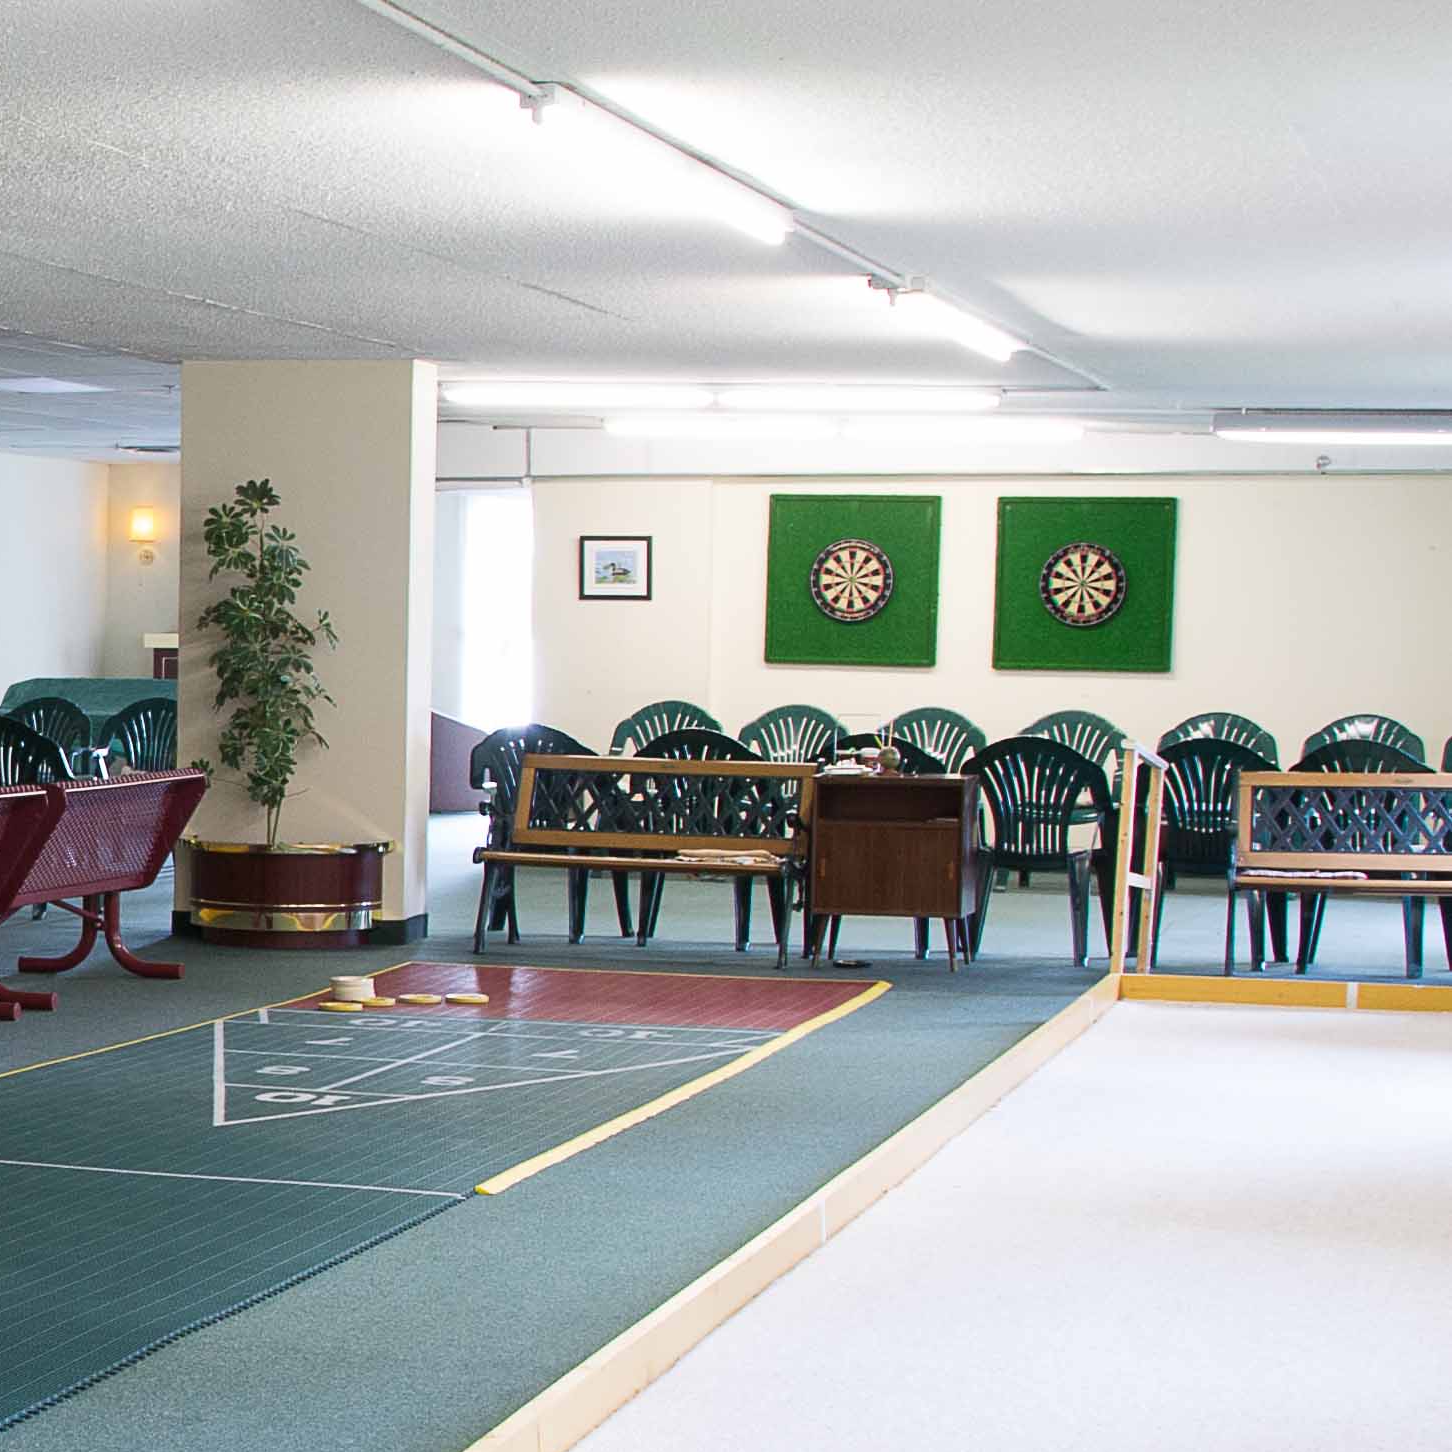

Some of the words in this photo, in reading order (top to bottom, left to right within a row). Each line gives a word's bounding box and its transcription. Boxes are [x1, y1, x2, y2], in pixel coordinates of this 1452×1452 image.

[305, 1037, 354, 1046] 7
[531, 1049, 580, 1060] 7
[255, 1065, 312, 1076] 8
[420, 1075, 475, 1086] 8
[254, 1091, 353, 1106] 10
